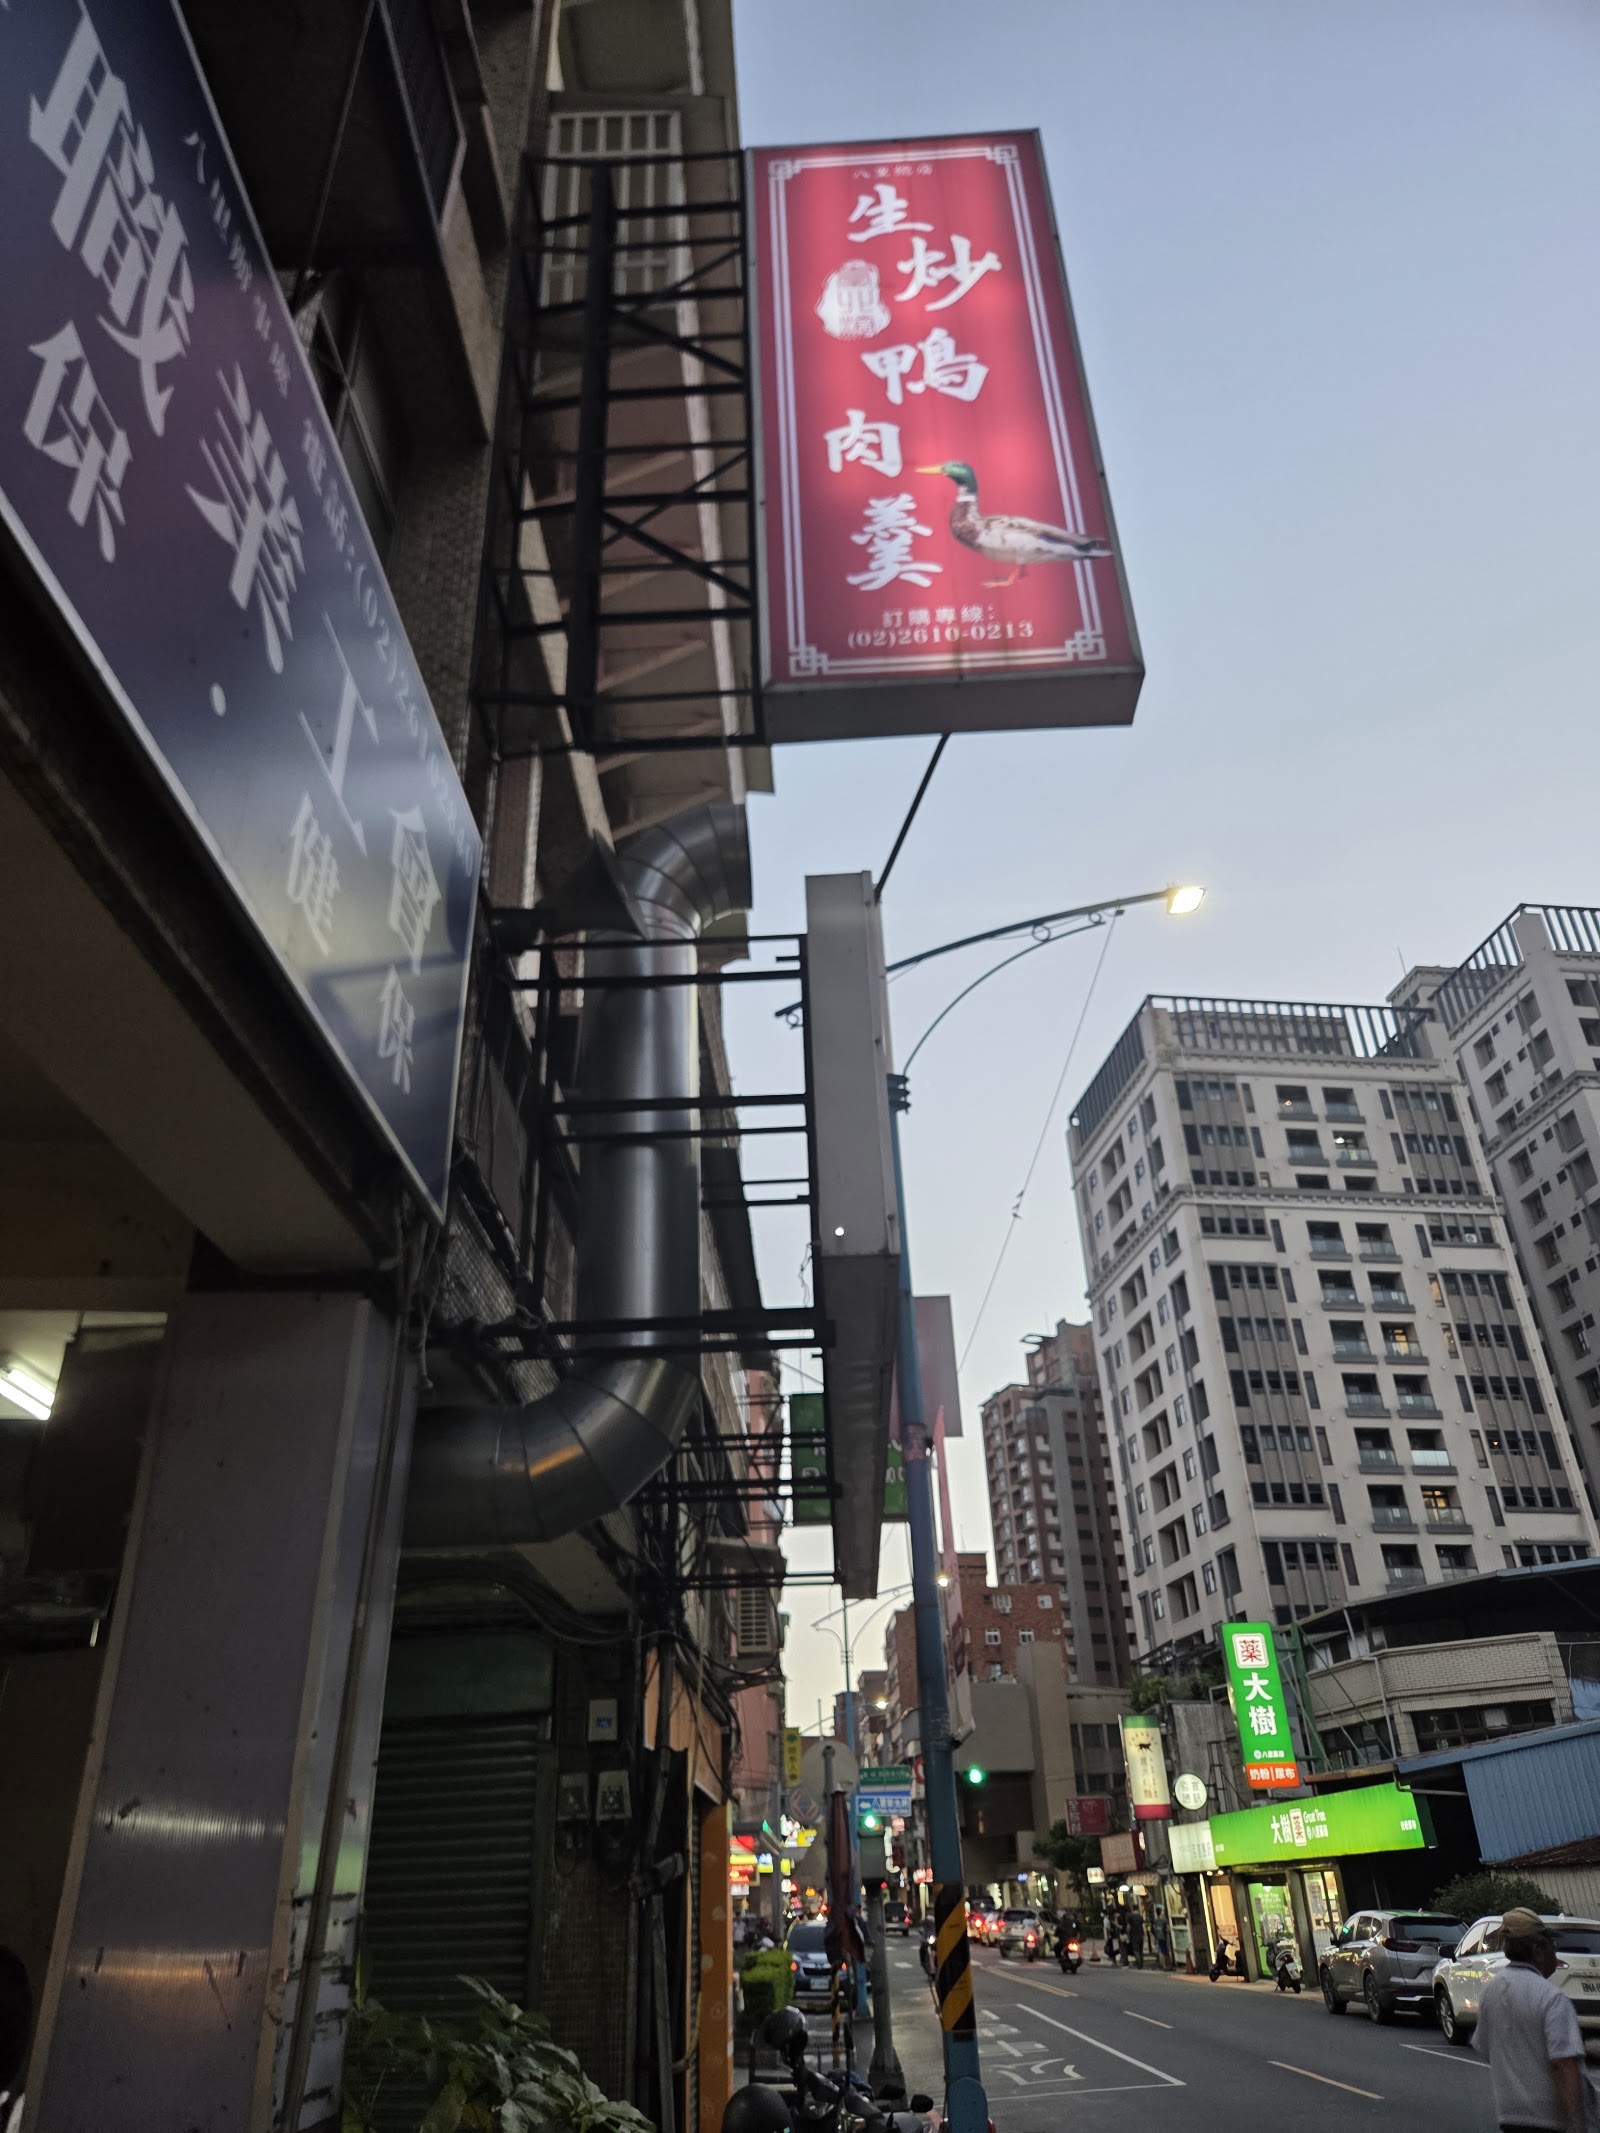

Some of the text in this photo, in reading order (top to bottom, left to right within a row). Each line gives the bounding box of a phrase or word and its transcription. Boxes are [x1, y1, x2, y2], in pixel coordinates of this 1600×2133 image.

[28, 0, 442, 977] 職業工會
[823, 184, 1002, 590] 生炒鴨肉羹
[847, 619, 1035, 650] (02)2610-0213
